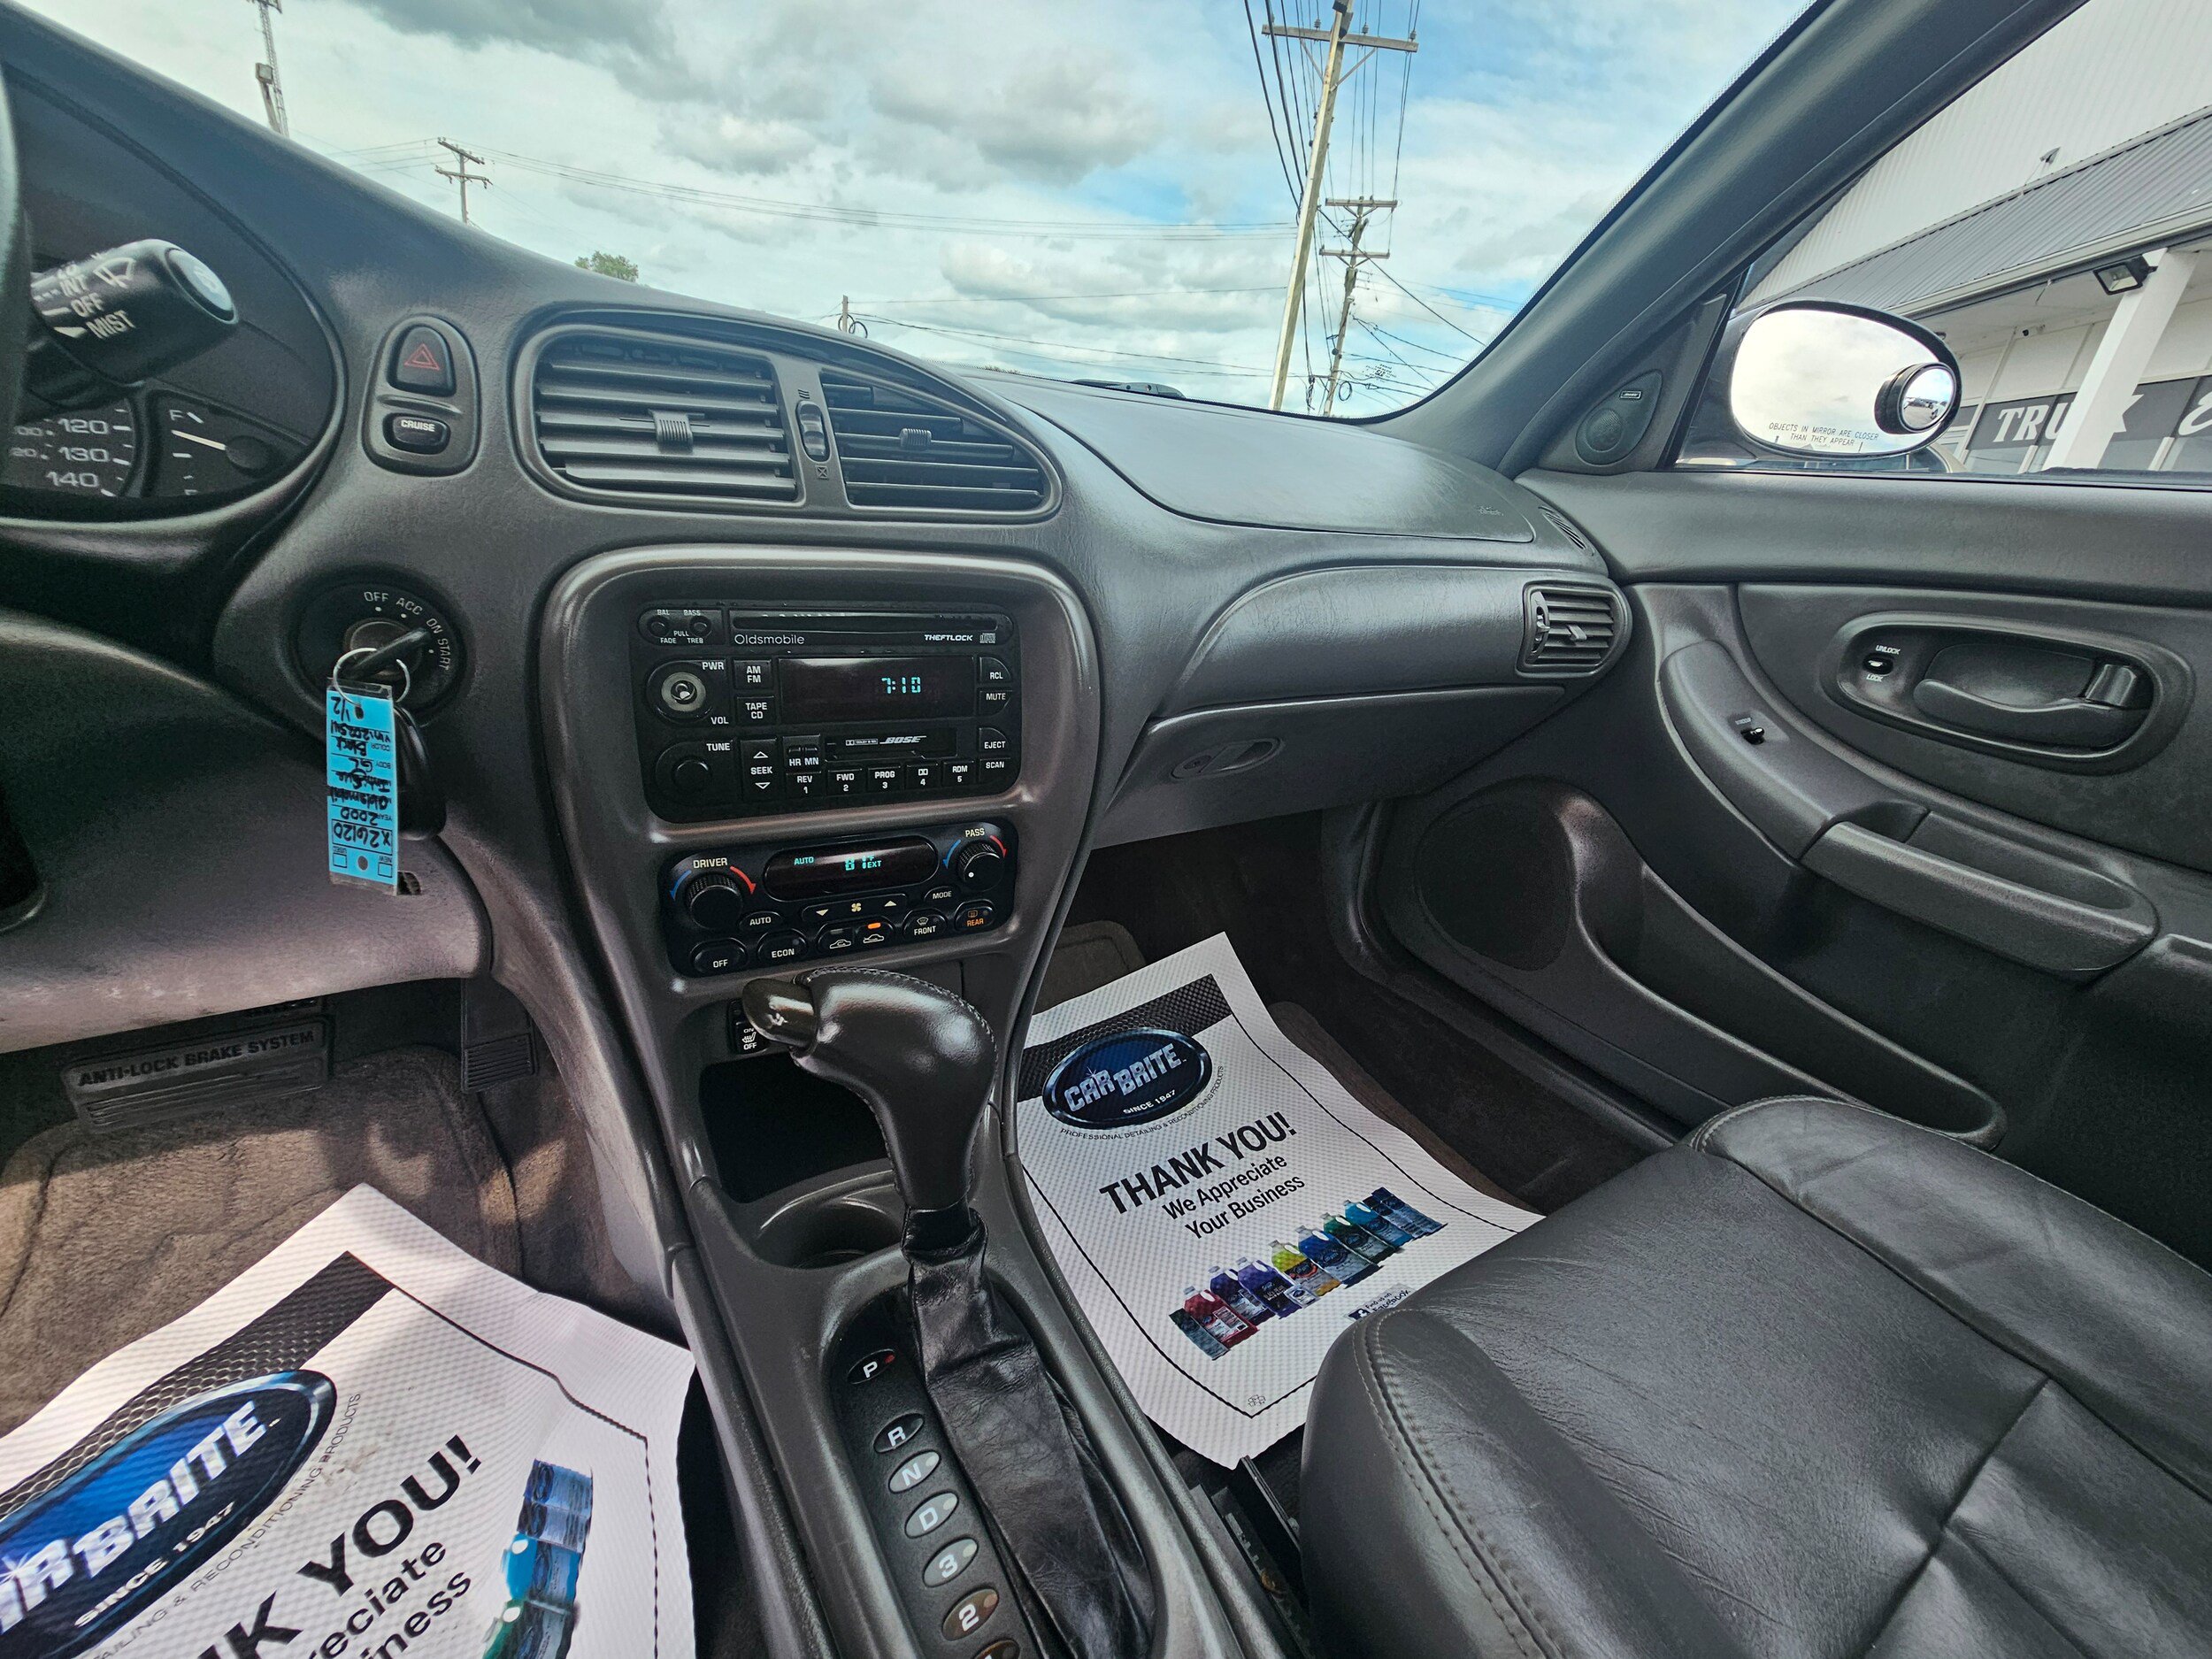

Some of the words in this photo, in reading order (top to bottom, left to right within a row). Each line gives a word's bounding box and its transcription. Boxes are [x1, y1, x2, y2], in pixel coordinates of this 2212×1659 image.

[59, 274, 89, 298] INT
[71, 292, 104, 318] OFF
[86, 310, 136, 340] MIST
[169, 409, 182, 421] F
[58, 418, 109, 434] 120
[401, 419, 435, 432] CRUISE
[1770, 422, 1798, 432] OBJECTS
[1812, 426, 1836, 435] MIRROR
[1855, 431, 1879, 441] CLOSER
[1830, 437, 1855, 446] APPEAR
[58, 446, 110, 463] 130
[46, 471, 100, 488] 140
[364, 592, 389, 602] OFF
[396, 597, 423, 616] ACC
[426, 618, 442, 634] ON
[734, 634, 805, 645] Oldsmobile
[437, 638, 451, 671] START
[1876, 645, 1901, 655] UNLOCK
[702, 662, 725, 671] PWR
[881, 677, 921, 695] 7:10
[1866, 673, 1883, 682] LOCK
[986, 693, 1006, 702] MUTE
[706, 742, 731, 751] TUNE
[881, 735, 926, 744] BOSE
[984, 741, 1006, 749] EJECT
[750, 766, 773, 775] SEEK
[788, 758, 802, 767] HR
[804, 757, 819, 766] MN
[796, 775, 813, 784] REV
[341, 807, 378, 826] 2000
[964, 828, 986, 838] PASS
[693, 857, 727, 869] DRIVER
[794, 856, 814, 865] AUTO
[933, 889, 952, 899] MODE
[749, 916, 772, 926] AUTO
[966, 918, 985, 927] REAR
[913, 926, 937, 935] FRONT
[771, 948, 795, 958] ECON
[712, 958, 729, 969] OFF
[78, 1059, 179, 1087] ANTI-LOCK
[184, 1046, 242, 1067] BRAKE
[247, 1031, 314, 1054] SYSTEM
[1064, 1069, 1116, 1112] CAR
[1114, 1043, 1183, 1096] BRITE
[1061, 1128, 1124, 1141] PROFESSIONAL
[1125, 1124, 1163, 1139] DETAILING
[1169, 1093, 1215, 1126] RECONDITIONING
[1210, 1065, 1225, 1095] PRODUCTS
[1123, 1101, 1154, 1114] SINCE
[1155, 1089, 1177, 1104] 1947
[1099, 1141, 1225, 1214] THANK
[1216, 1110, 1297, 1161] YOU!
[1162, 1193, 1197, 1221] We
[1197, 1154, 1288, 1209] Appreciate
[1185, 1210, 1228, 1240] Your
[1227, 1174, 1305, 1220] Business
[863, 1361, 878, 1379] P
[887, 1425, 907, 1447] R
[902, 1463, 923, 1486] N
[189, 1464, 323, 1593] RECONDITIONING
[319, 1392, 362, 1465] PRODUCTS
[0, 1539, 74, 1635] AR
[73, 1400, 267, 1580] BRITE
[296, 1434, 482, 1598] YOU!
[918, 1508, 940, 1532] D
[74, 1556, 170, 1629] SINCE
[172, 1501, 235, 1554] 1947
[939, 1554, 960, 1578] 3
[958, 1604, 979, 1632] 2
